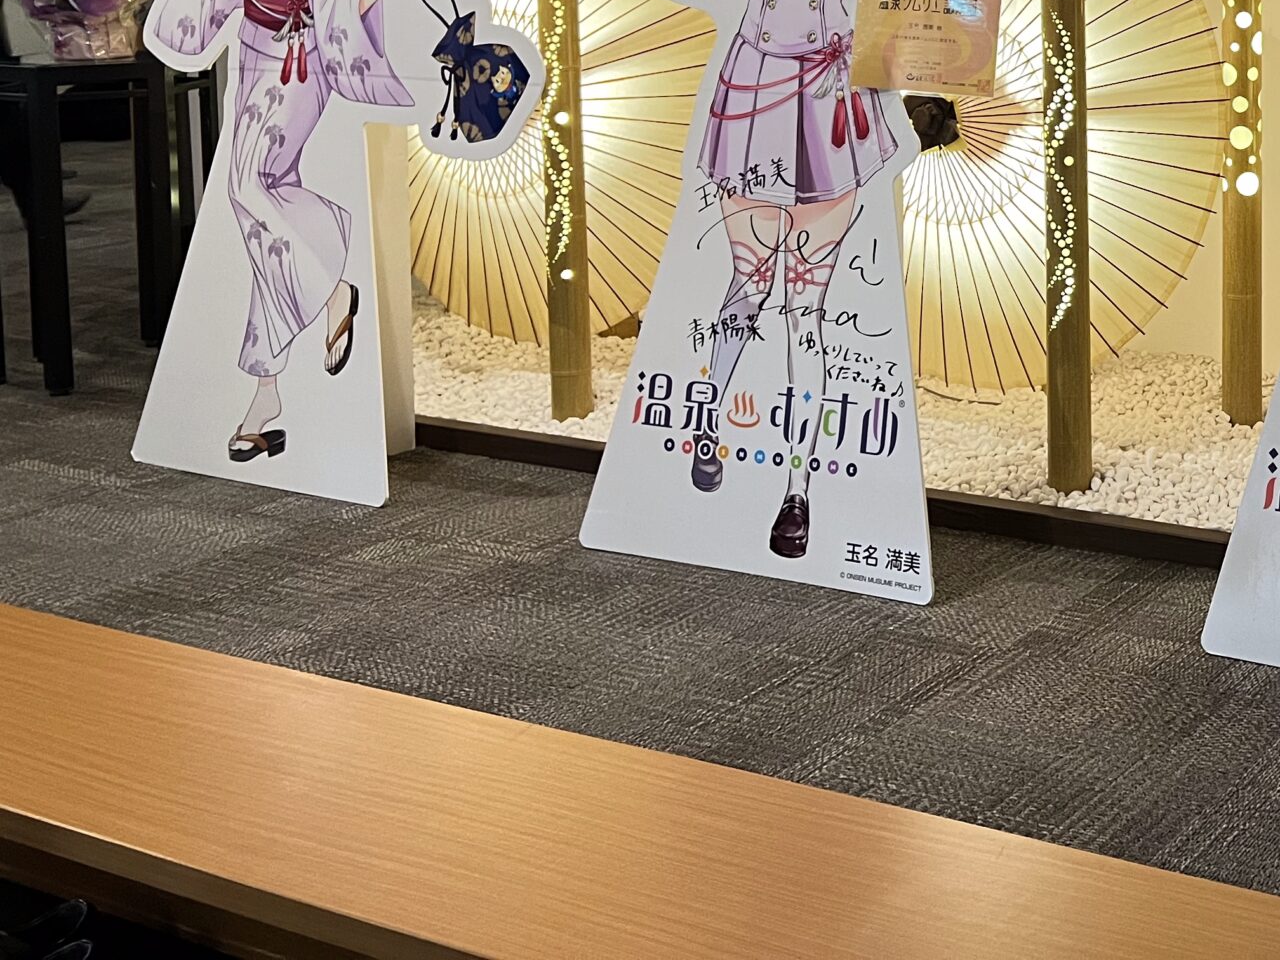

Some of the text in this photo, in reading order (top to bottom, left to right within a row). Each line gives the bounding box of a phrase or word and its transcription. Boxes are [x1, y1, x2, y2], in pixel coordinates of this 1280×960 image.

[845, 542, 921, 575] 玉名 満美
[846, 573, 867, 583] ONSEN
[868, 576, 893, 587] MUSUME
[895, 581, 922, 593] PROJECT
